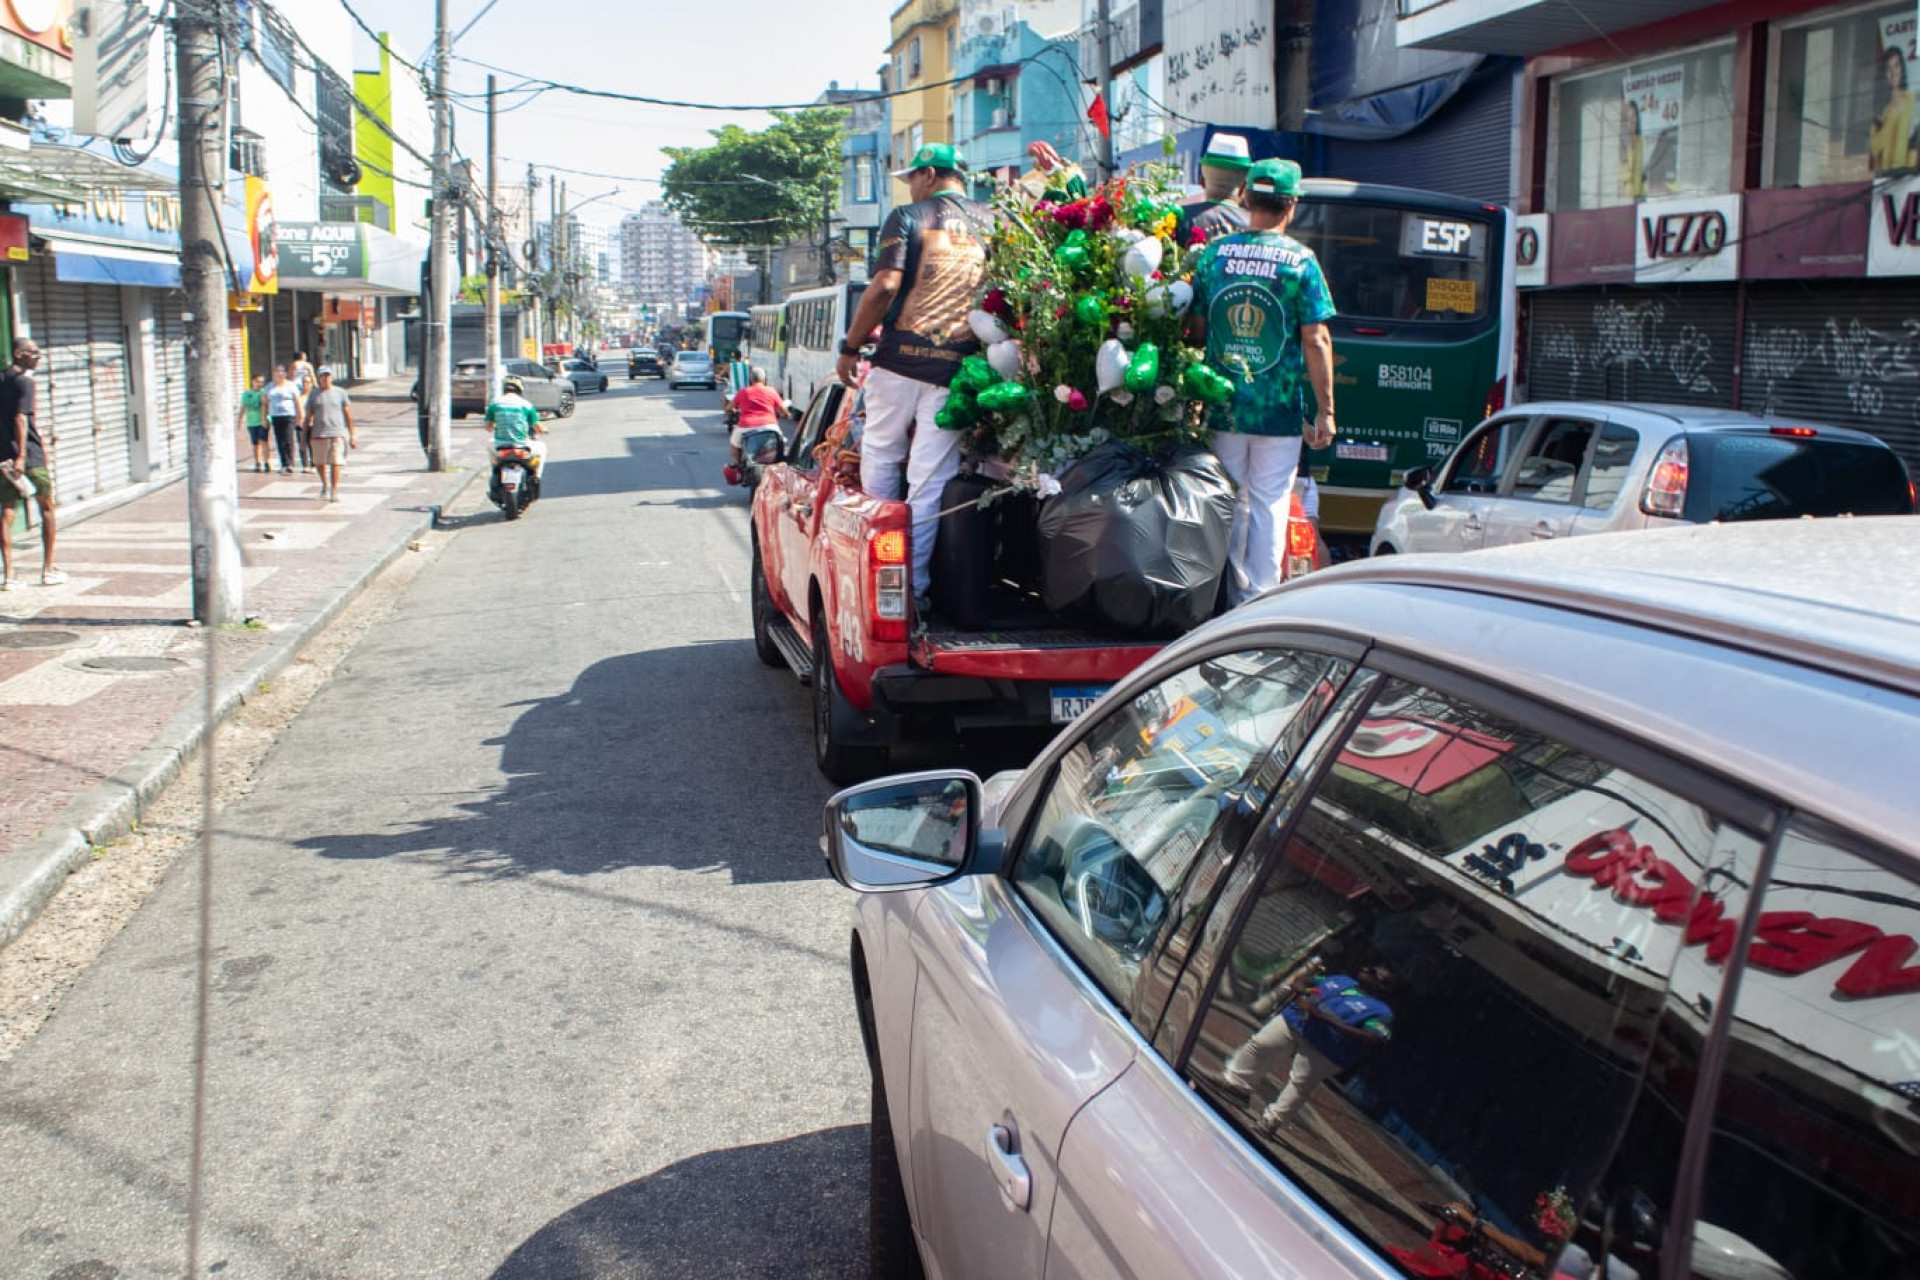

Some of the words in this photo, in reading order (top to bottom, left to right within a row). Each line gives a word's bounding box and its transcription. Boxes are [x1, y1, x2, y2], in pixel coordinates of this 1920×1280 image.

[1422, 220, 1472, 254] ESP
[1642, 209, 1728, 259] VEZZO
[1216, 243, 1301, 266] DEPARTAMENTO
[1225, 259, 1277, 279] SOCIAL
[1429, 279, 1473, 293] DISQUE
[1378, 364, 1433, 382] B58104
[1377, 379, 1433, 391] INTERNORTE
[1337, 426, 1420, 439] ONDICIONADO
[836, 608, 864, 664] 193
